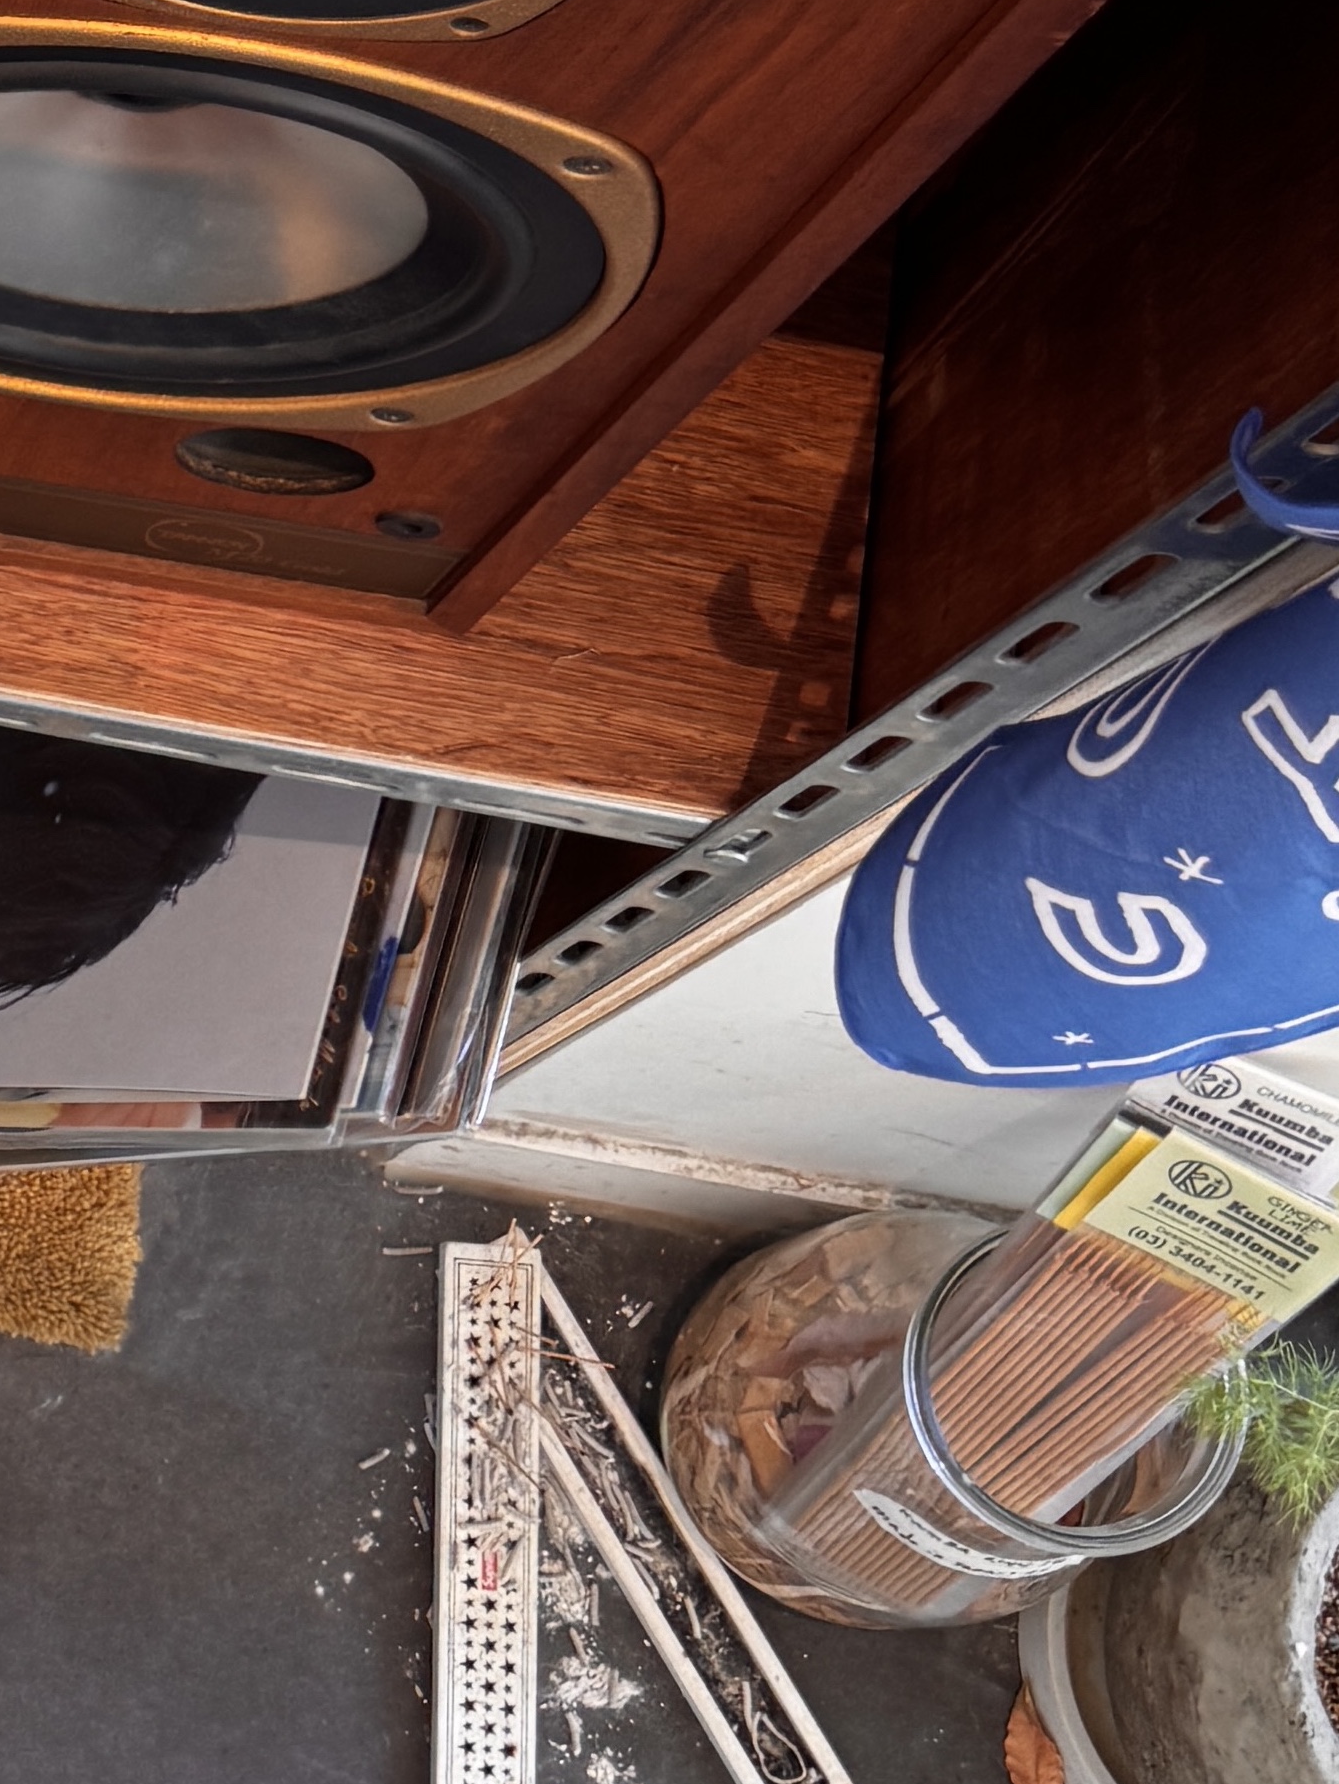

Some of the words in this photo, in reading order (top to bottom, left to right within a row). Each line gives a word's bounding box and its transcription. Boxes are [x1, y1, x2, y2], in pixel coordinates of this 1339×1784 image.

[1164, 1095, 1316, 1167] International
[1237, 1098, 1335, 1146] Kuumba
[1126, 1225, 1168, 1251] (03)
[1168, 1243, 1266, 1301] 3404-1141
[1151, 1192, 1302, 1274] International
[1226, 1200, 1320, 1256] Kuumba
